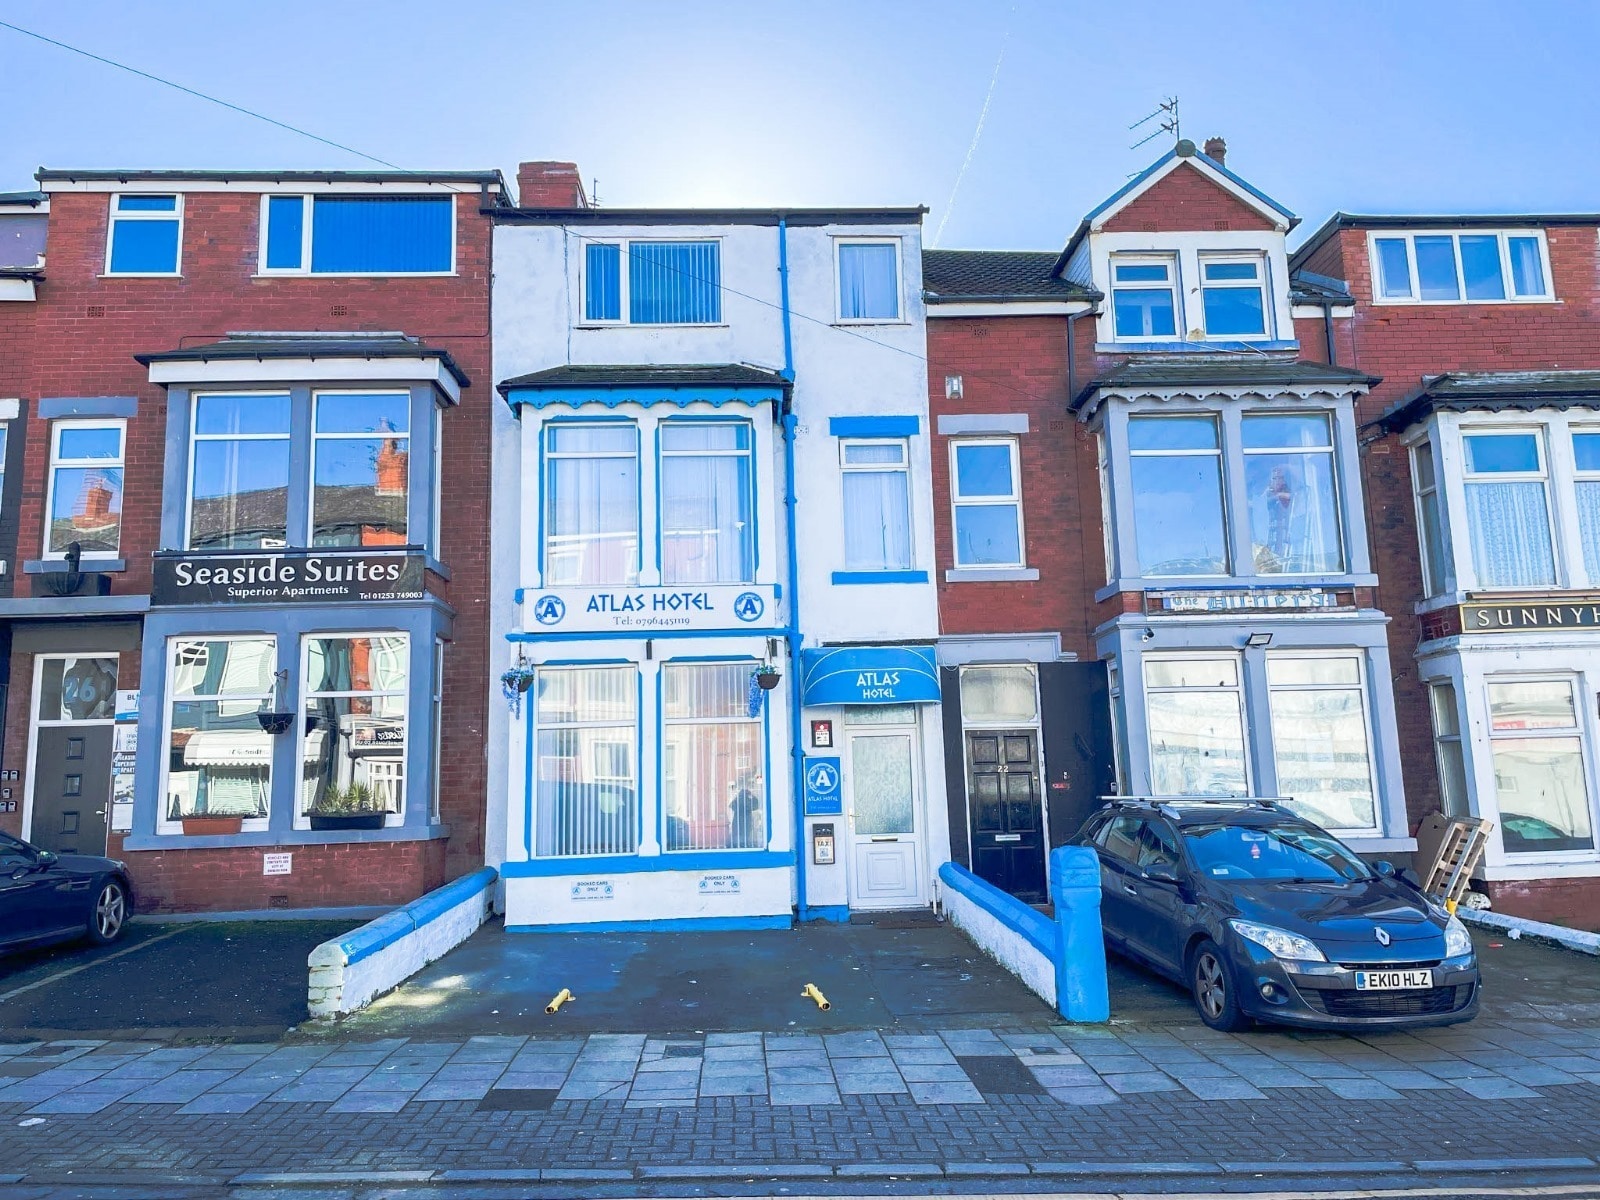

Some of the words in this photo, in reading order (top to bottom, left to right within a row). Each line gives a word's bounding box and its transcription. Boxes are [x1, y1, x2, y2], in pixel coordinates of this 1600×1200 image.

[175, 557, 295, 586] Seaside
[305, 558, 400, 583] Suites
[227, 586, 278, 597] Superior
[281, 585, 349, 597] Apartments
[359, 592, 371, 600] Tel
[372, 592, 394, 600] 01253
[396, 591, 423, 599] 749003
[586, 593, 645, 612] ATLAS
[652, 592, 714, 611] HOTEL
[613, 616, 633, 625] Tel:
[635, 616, 690, 626] 07964451119
[856, 671, 900, 687] ATLAS
[64, 676, 96, 702] 26
[862, 688, 896, 699] HOTEL
[1369, 973, 1400, 987] EK10
[1403, 972, 1428, 987] HLZ
